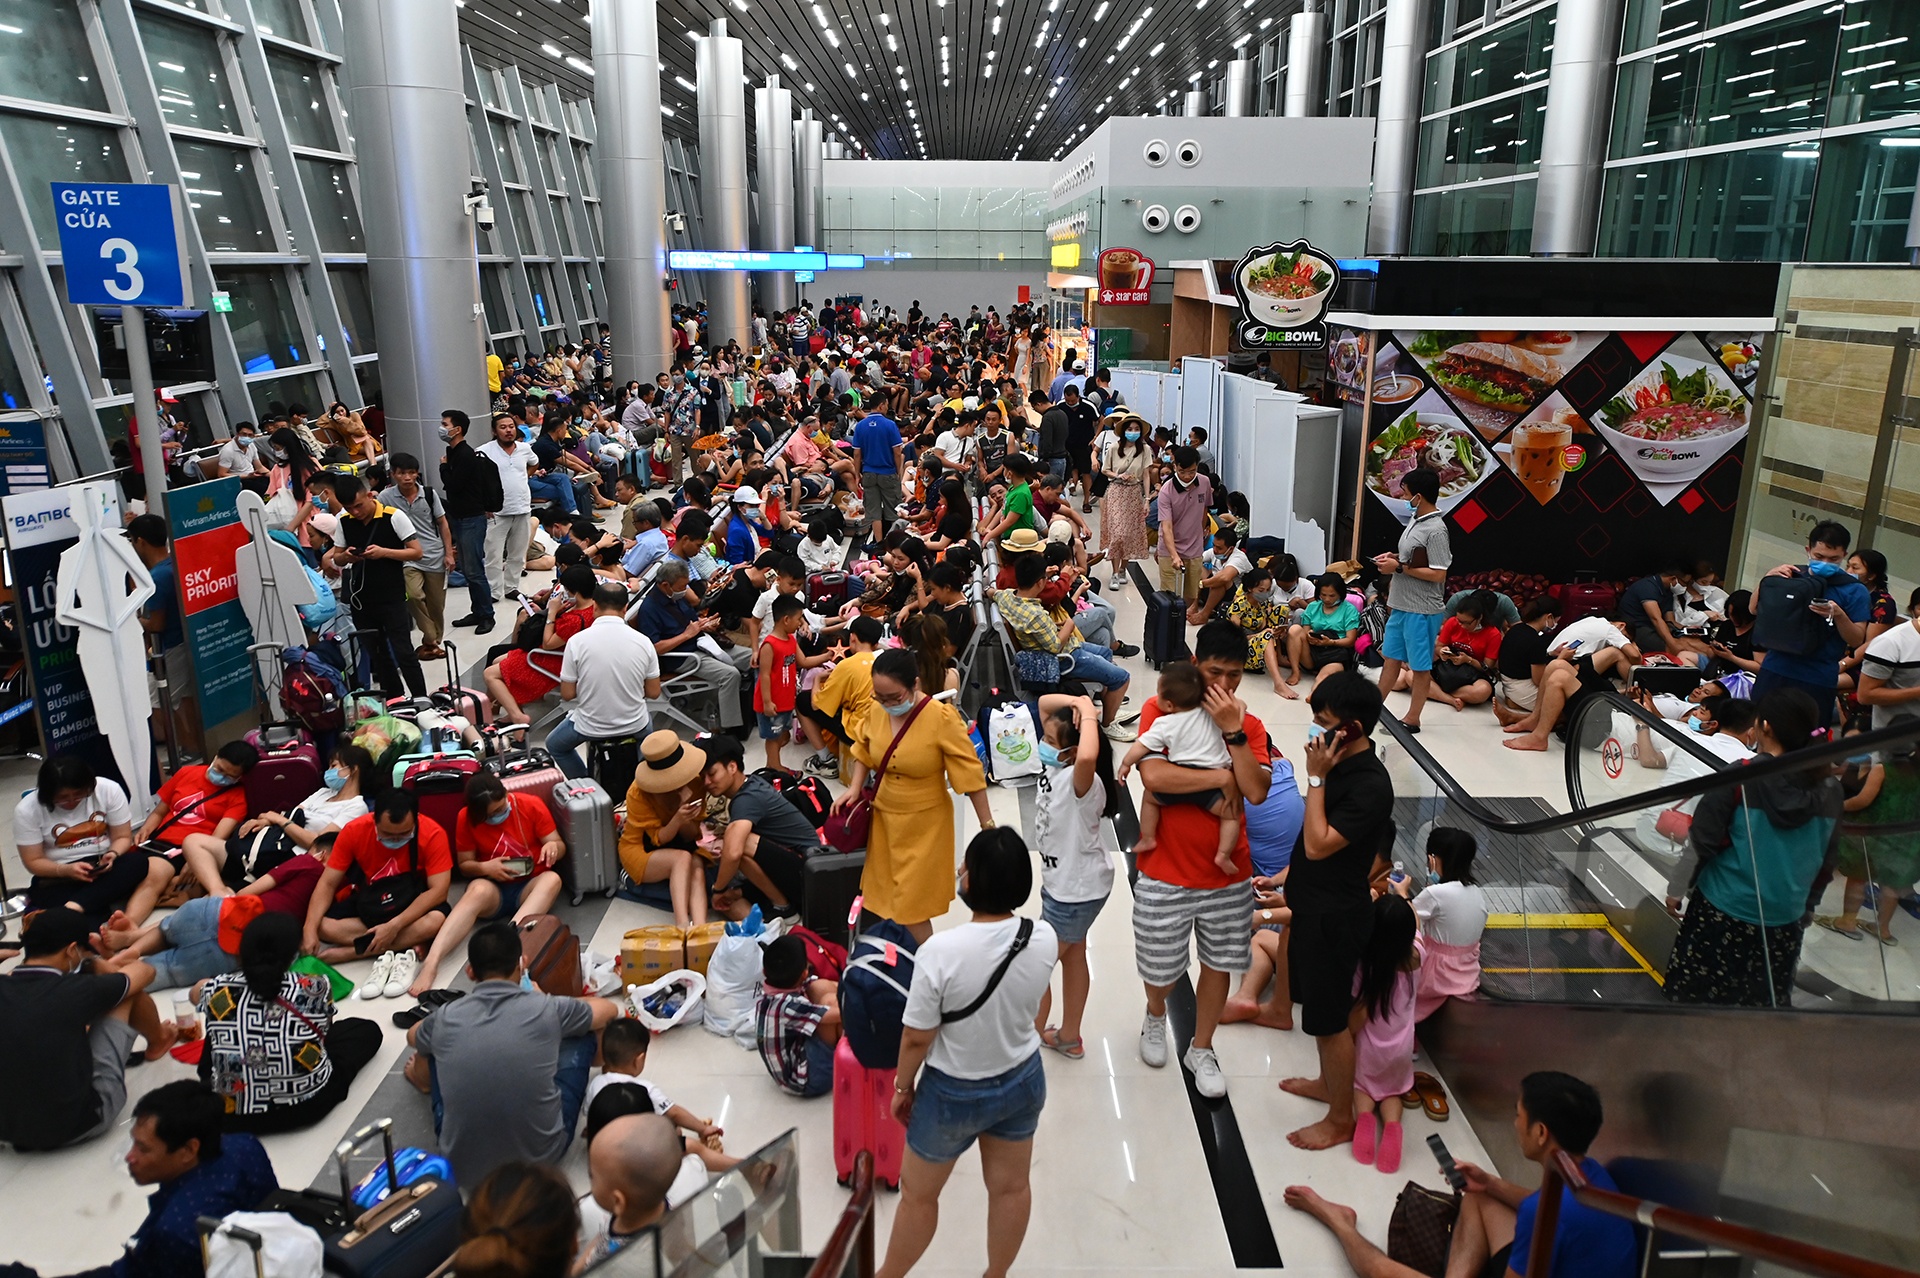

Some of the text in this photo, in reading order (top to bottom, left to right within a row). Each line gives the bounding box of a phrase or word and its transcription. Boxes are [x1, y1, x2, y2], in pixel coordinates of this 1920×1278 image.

[61, 189, 120, 206] GATE
[64, 208, 112, 229] CỬA
[99, 238, 144, 301] 3
[1671, 451, 1700, 461] BOWL
[185, 567, 212, 586] SKY
[43, 683, 63, 697] VIP
[49, 711, 68, 725] CIP
